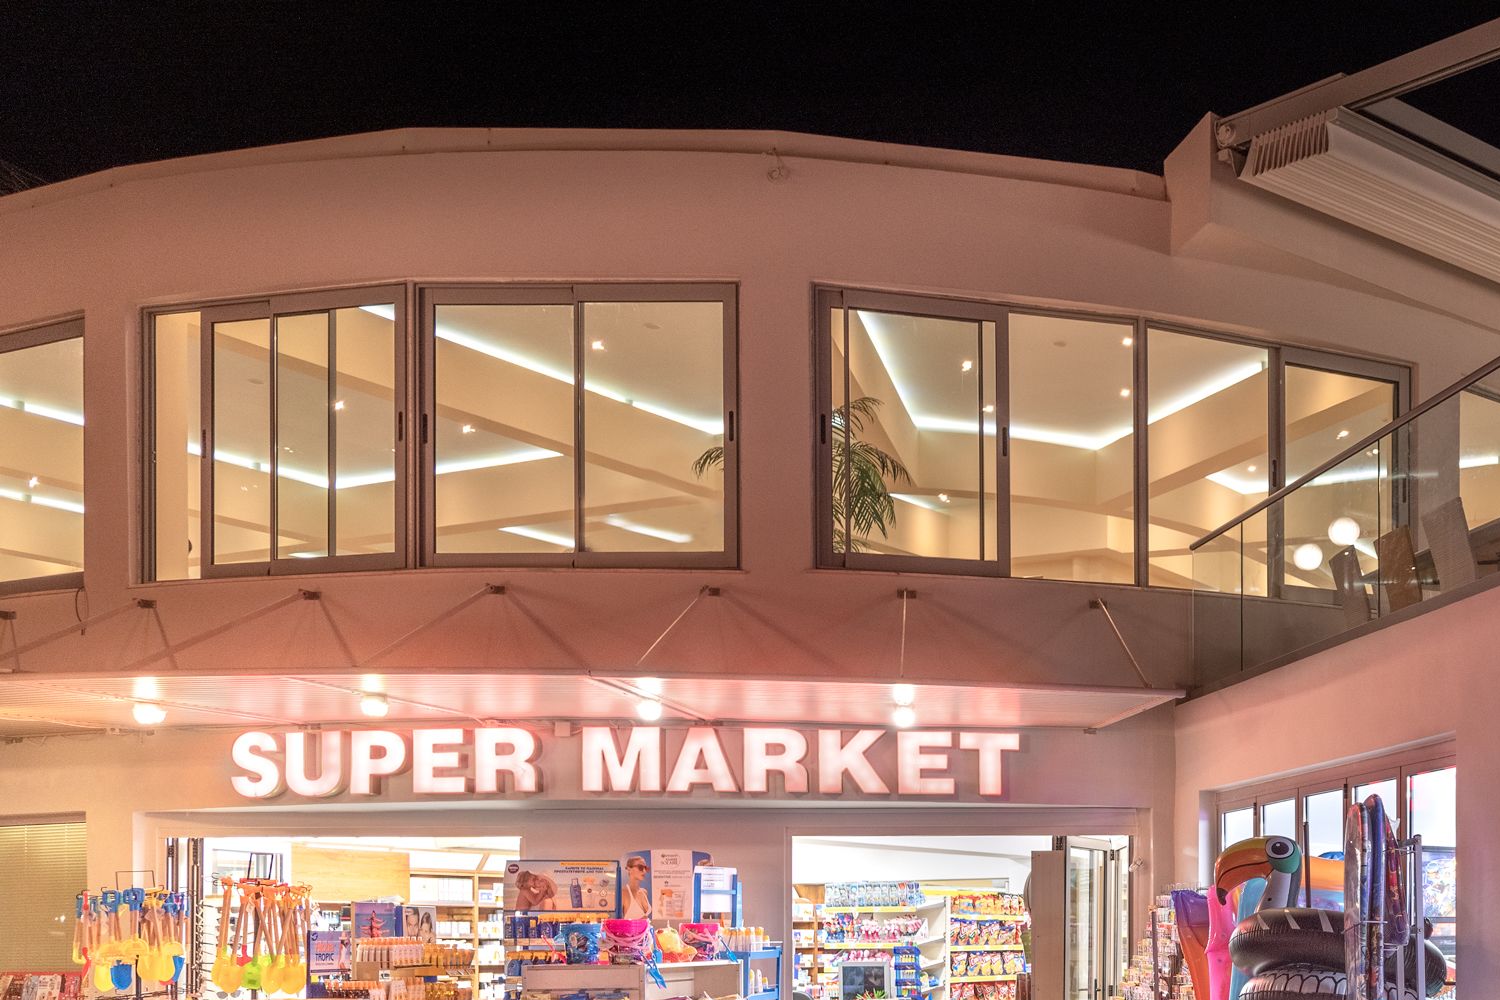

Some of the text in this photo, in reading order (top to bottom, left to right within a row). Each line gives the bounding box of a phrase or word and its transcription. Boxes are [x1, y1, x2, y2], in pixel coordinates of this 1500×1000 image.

[230, 726, 1021, 799] SUPER MARKET
[315, 953, 335, 961] TROPIC
